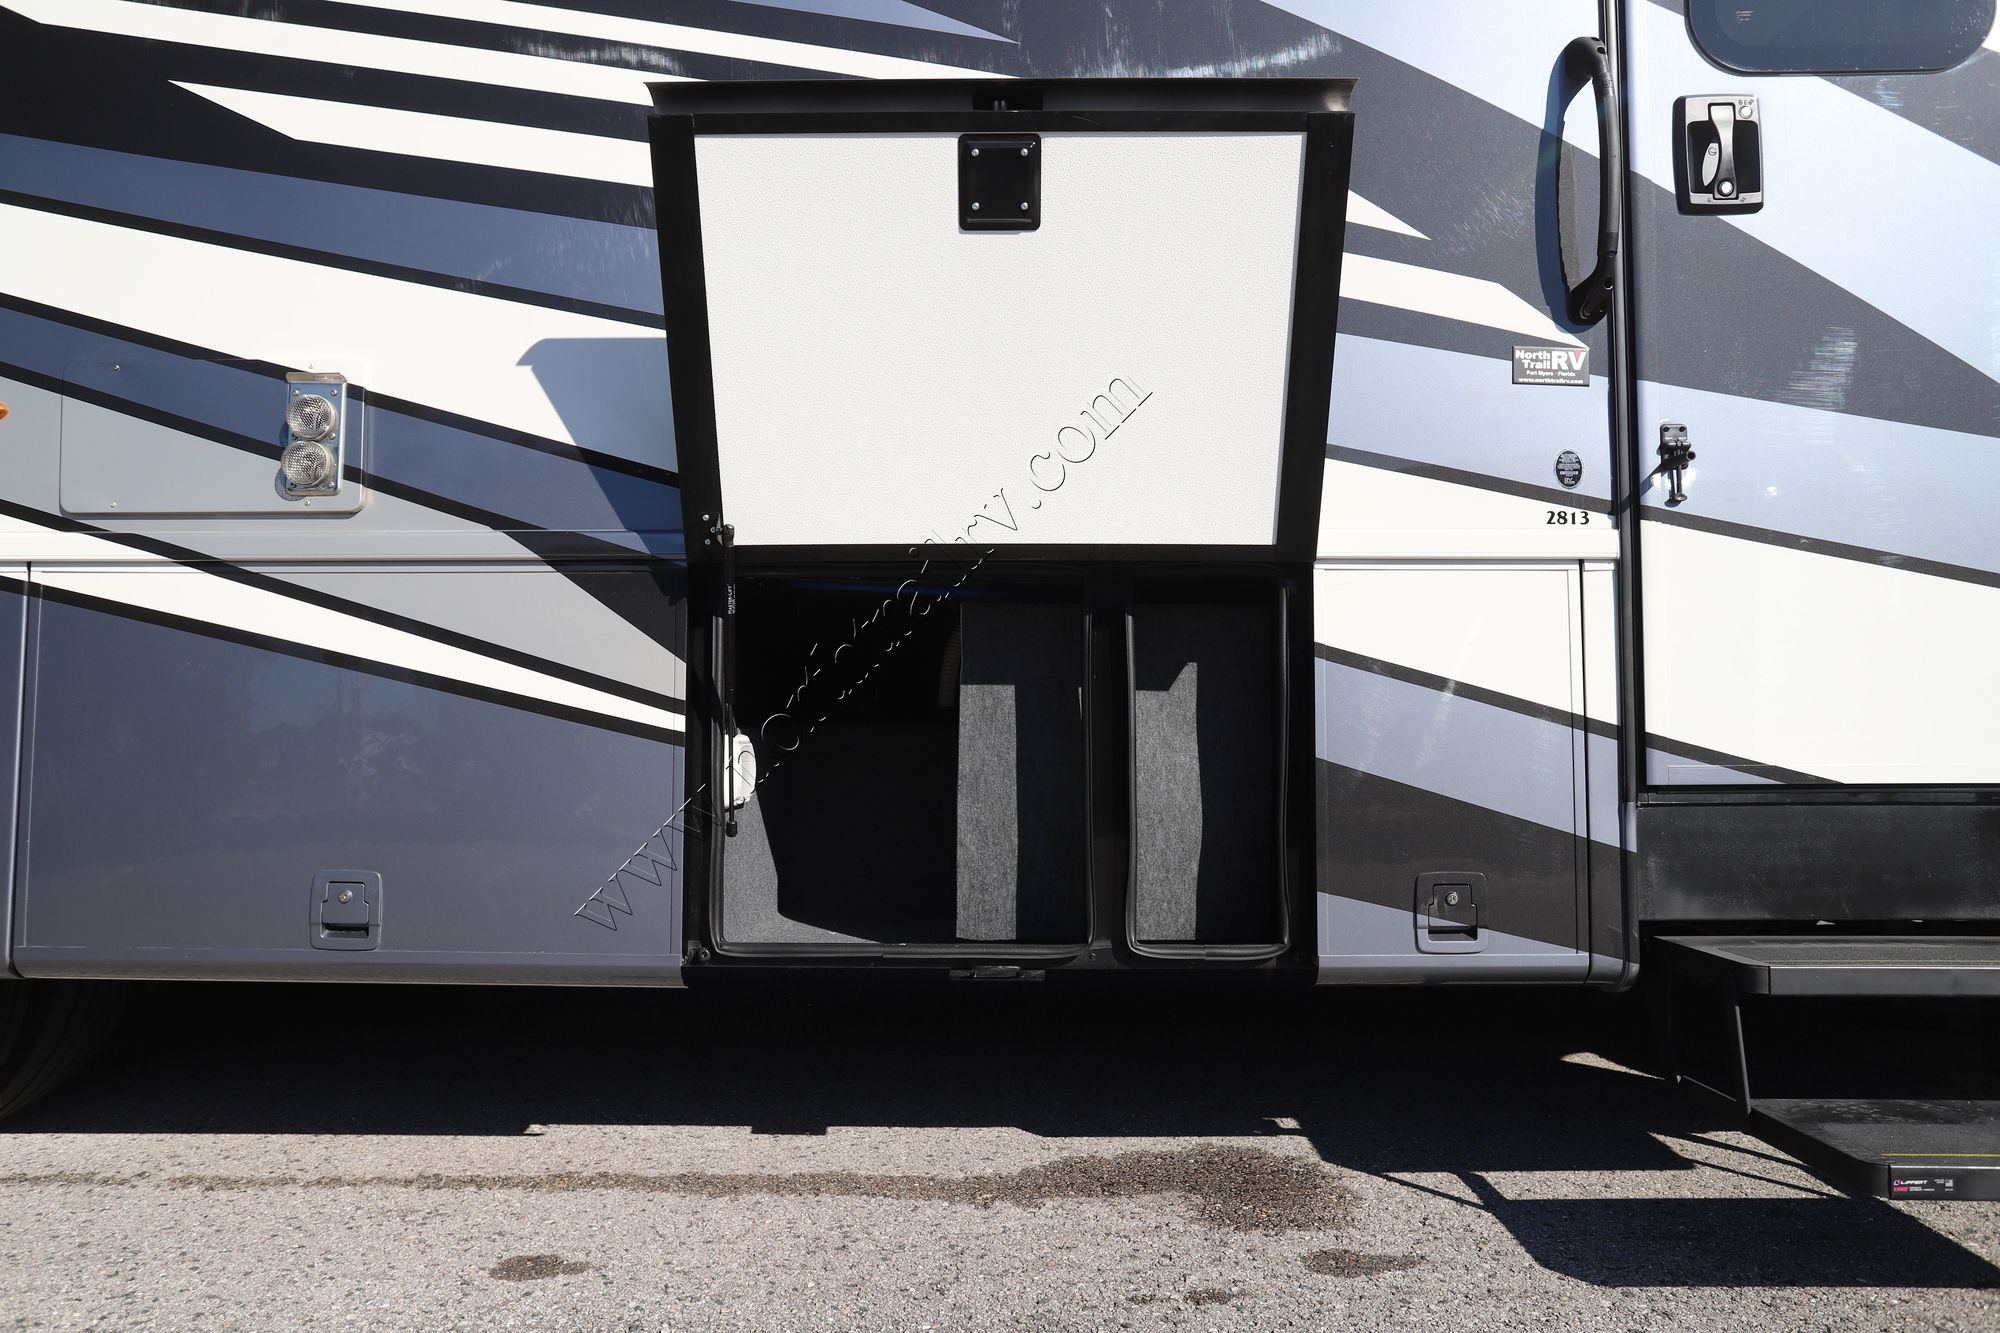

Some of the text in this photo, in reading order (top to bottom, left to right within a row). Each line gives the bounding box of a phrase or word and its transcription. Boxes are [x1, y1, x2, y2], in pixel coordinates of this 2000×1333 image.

[1515, 349, 1551, 360] North
[1551, 350, 1587, 371] RV
[1521, 359, 1551, 370] Trail
[1546, 510, 1590, 525] 2813
